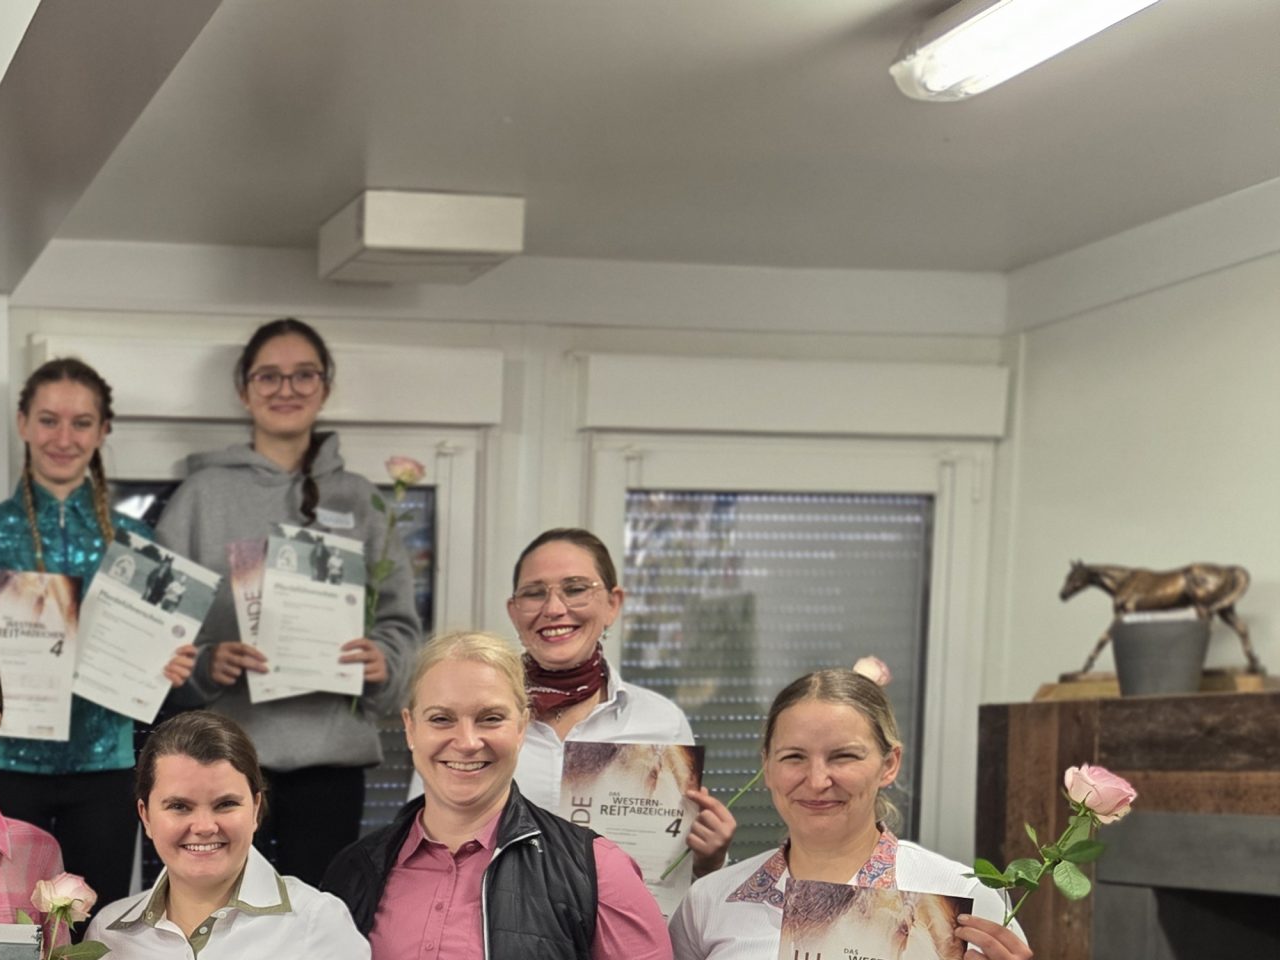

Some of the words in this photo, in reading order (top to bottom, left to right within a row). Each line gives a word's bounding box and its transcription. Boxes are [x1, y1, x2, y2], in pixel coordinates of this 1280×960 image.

[49, 639, 64, 657] 4
[612, 796, 664, 807] WESTERN-
[599, 804, 685, 817] REITABZEICHEN
[665, 817, 683, 838] 4
[843, 947, 859, 956] DAS
